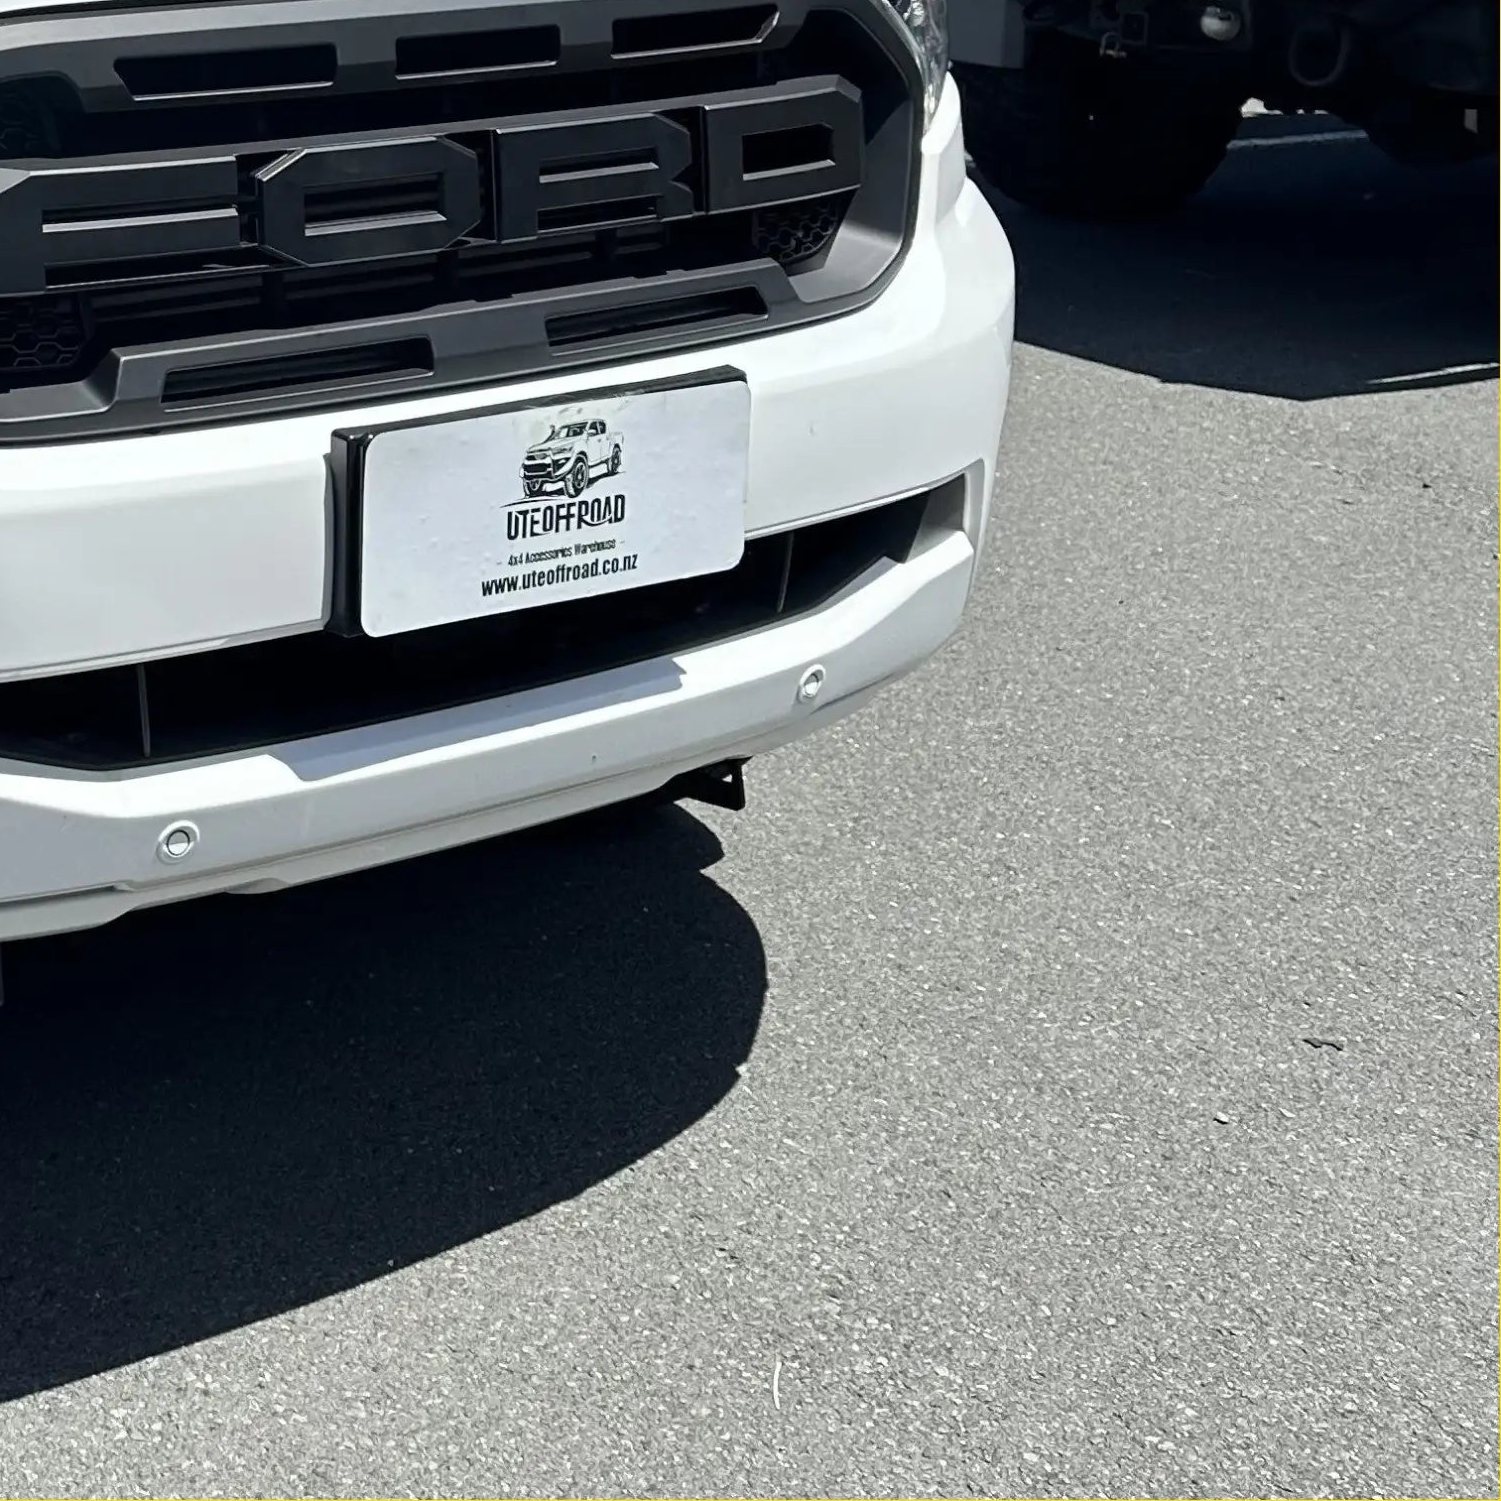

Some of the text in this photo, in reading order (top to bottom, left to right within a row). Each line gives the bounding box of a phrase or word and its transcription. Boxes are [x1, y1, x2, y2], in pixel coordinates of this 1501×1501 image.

[508, 539, 617, 567] 4x4 Accessories Warehouse
[481, 554, 638, 597] www.uteoffroad.co.nz
